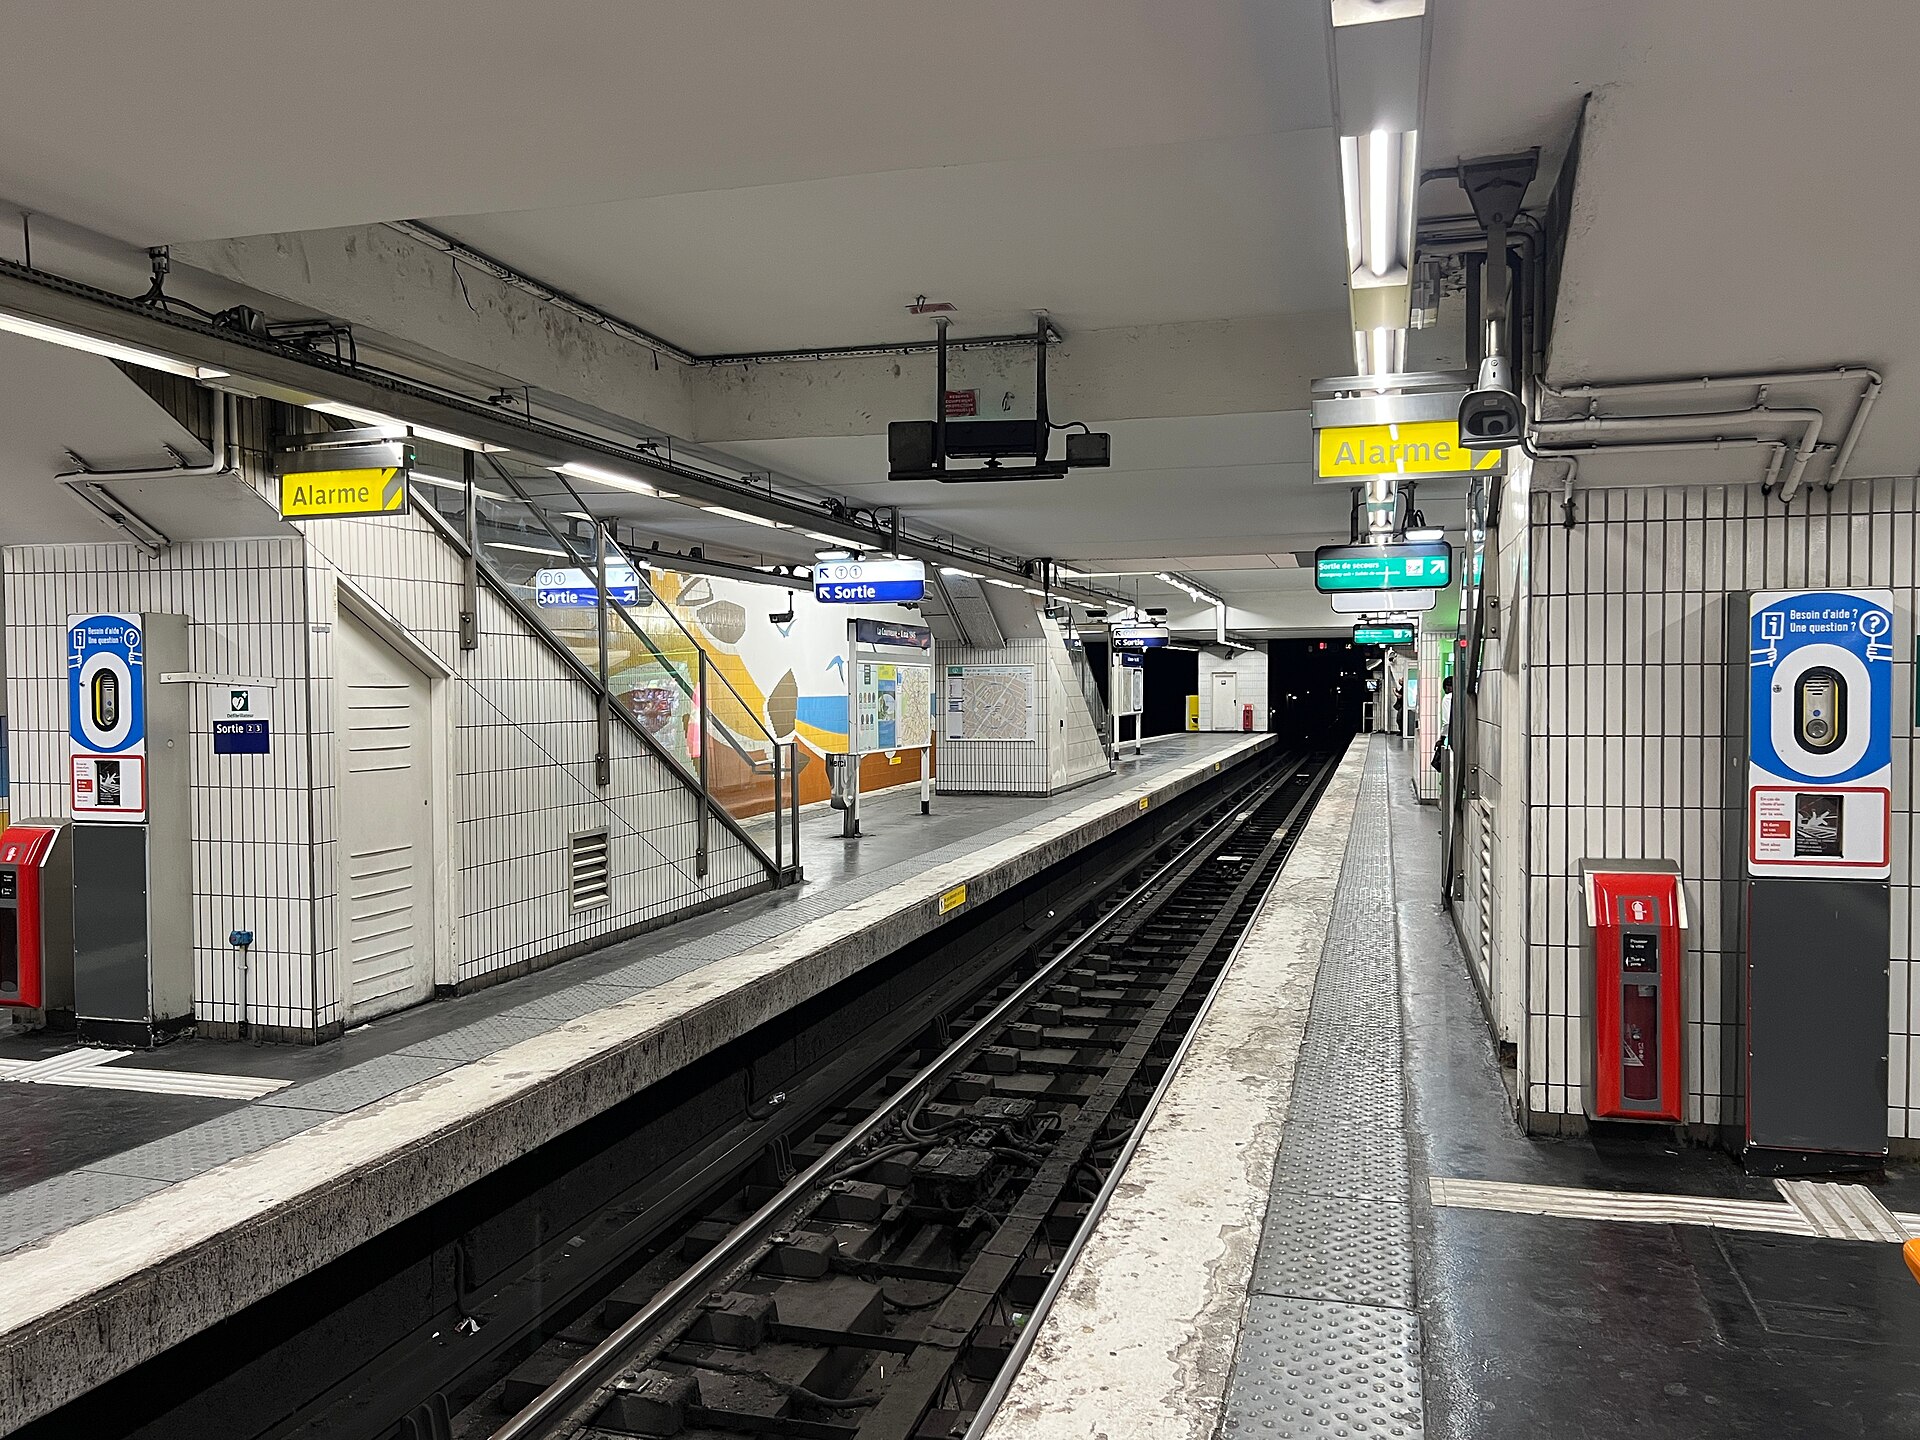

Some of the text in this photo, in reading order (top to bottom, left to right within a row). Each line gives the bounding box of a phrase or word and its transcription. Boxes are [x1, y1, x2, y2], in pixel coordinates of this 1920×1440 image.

[1334, 439, 1450, 466] Alarme
[292, 485, 369, 506] Alarme
[1319, 562, 1340, 570] Sortie
[539, 590, 578, 604] Sortie
[834, 585, 876, 599] Sortie
[1790, 609, 1858, 620] Besoin d'aide ?
[1790, 622, 1857, 634] Une question ?
[216, 724, 243, 734] Sortie
[830, 759, 847, 767] Merci
